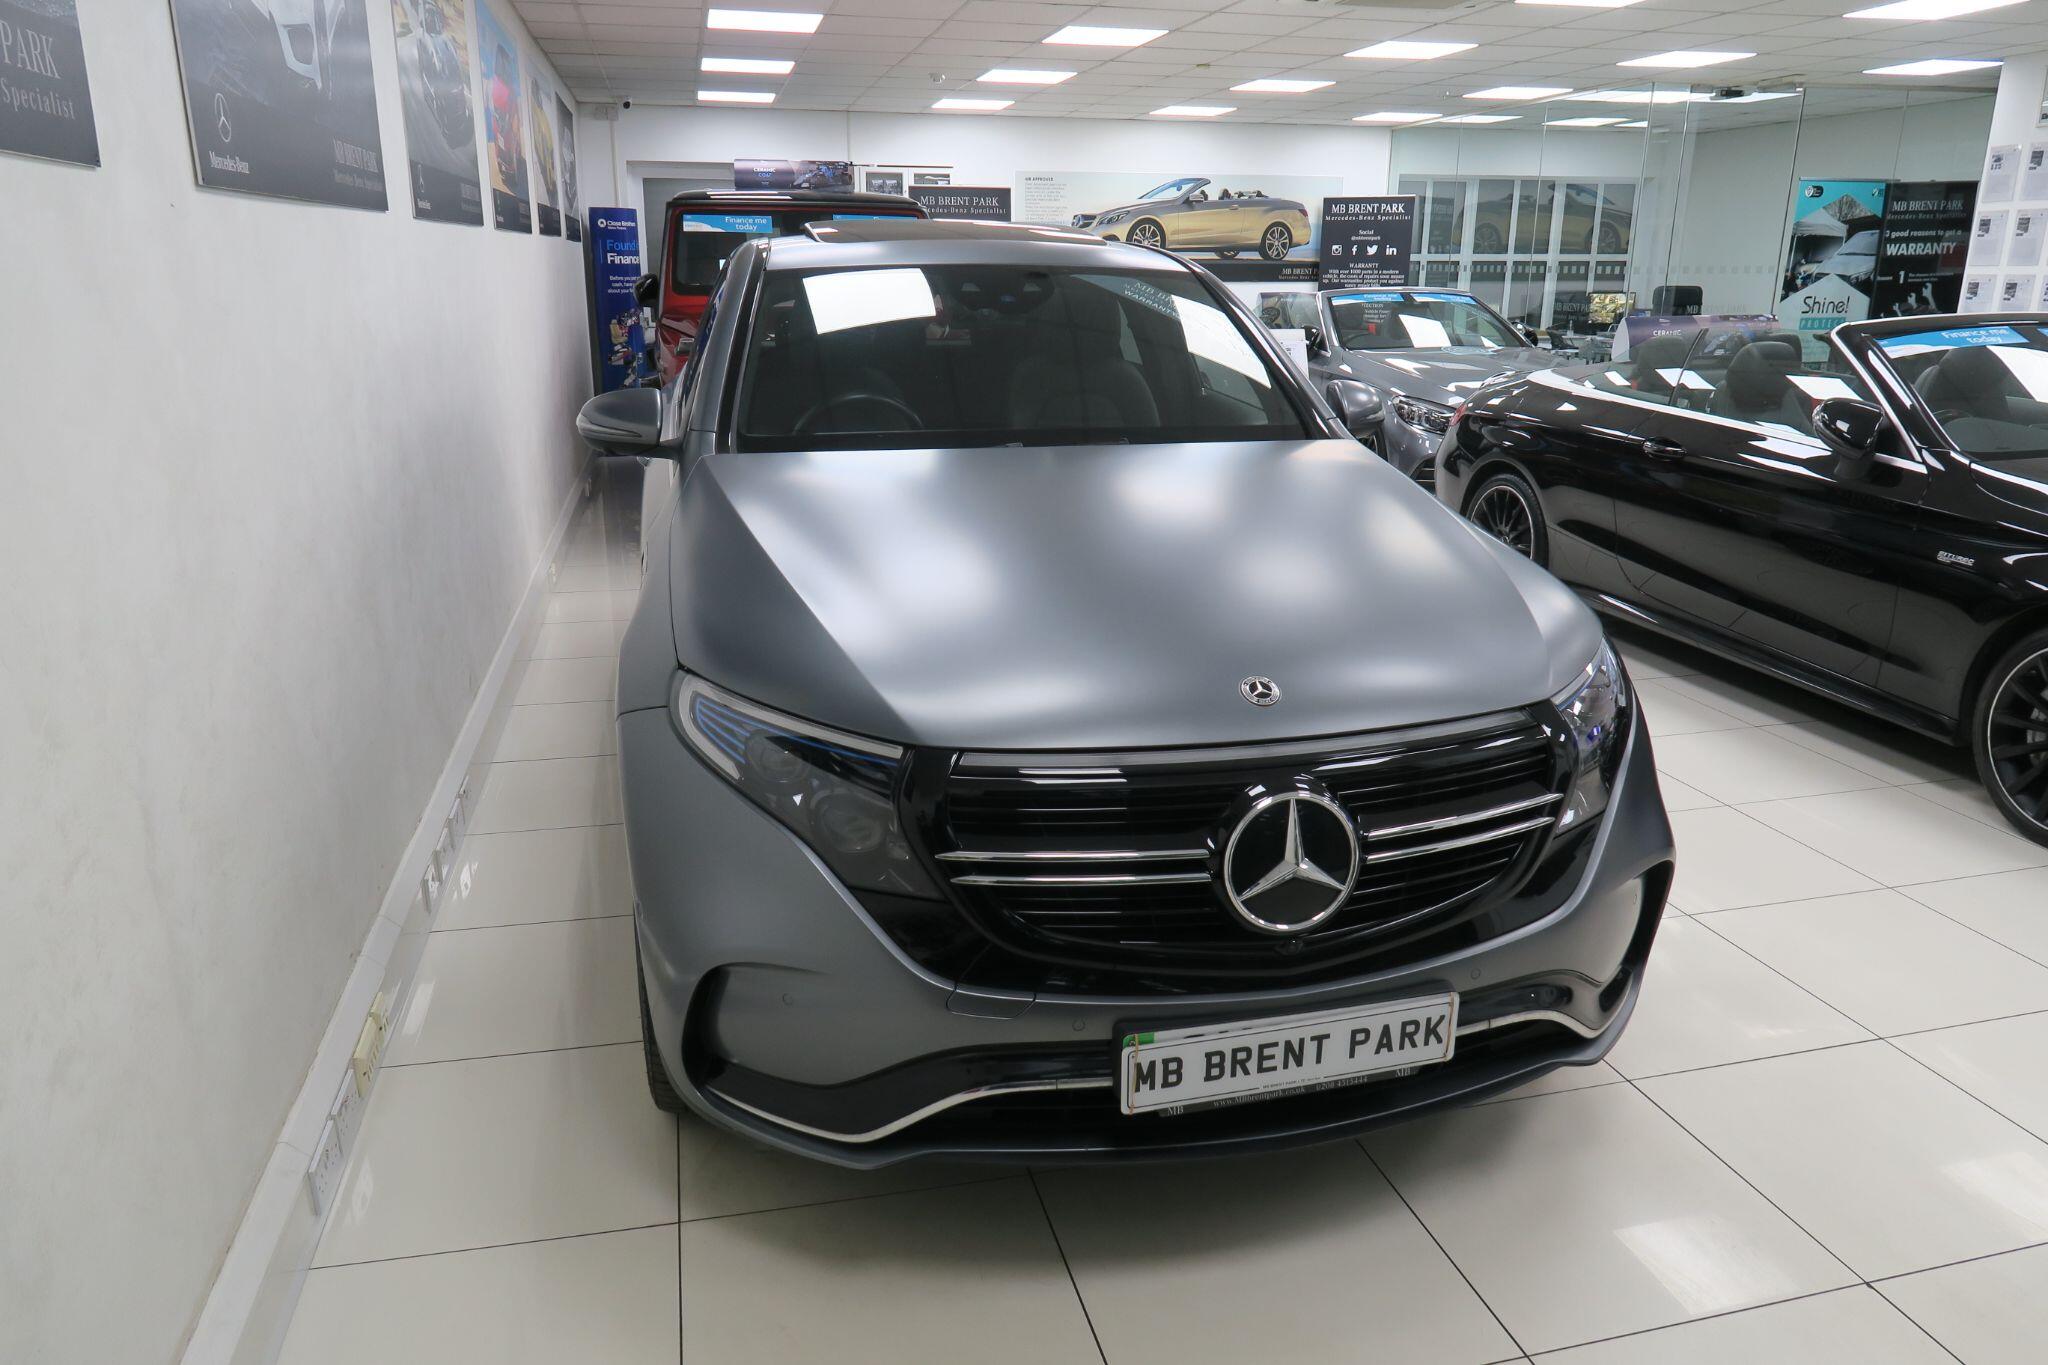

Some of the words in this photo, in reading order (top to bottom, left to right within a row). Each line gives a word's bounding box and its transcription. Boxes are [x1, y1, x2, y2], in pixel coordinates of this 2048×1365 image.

[0, 20, 61, 79] PARK
[0, 77, 75, 120] Specialist
[920, 195, 935, 205] MB
[938, 196, 969, 206] BRENT
[973, 196, 999, 206] PARK
[1892, 200, 1907, 211] MB
[1908, 200, 1938, 211] BRENT
[1940, 200, 1963, 210] PARK
[970, 207, 1007, 215] Specialist
[1331, 203, 1346, 214] MB
[1348, 203, 1380, 214] BRENT
[1381, 203, 1405, 213] PARK
[735, 223, 758, 231] today
[1891, 229, 1909, 238] good
[1886, 242, 1957, 256] WARRANTY
[1899, 270, 1905, 284] 1
[1801, 296, 1850, 314] Shine!
[1941, 329, 1988, 339] Finance
[1989, 328, 2009, 336] me
[1966, 336, 2002, 344] today
[1134, 1056, 1184, 1093] MB
[1203, 1033, 1331, 1083] BRENT
[1348, 1014, 1446, 1059] PARK
[1168, 1104, 1184, 1116] MB
